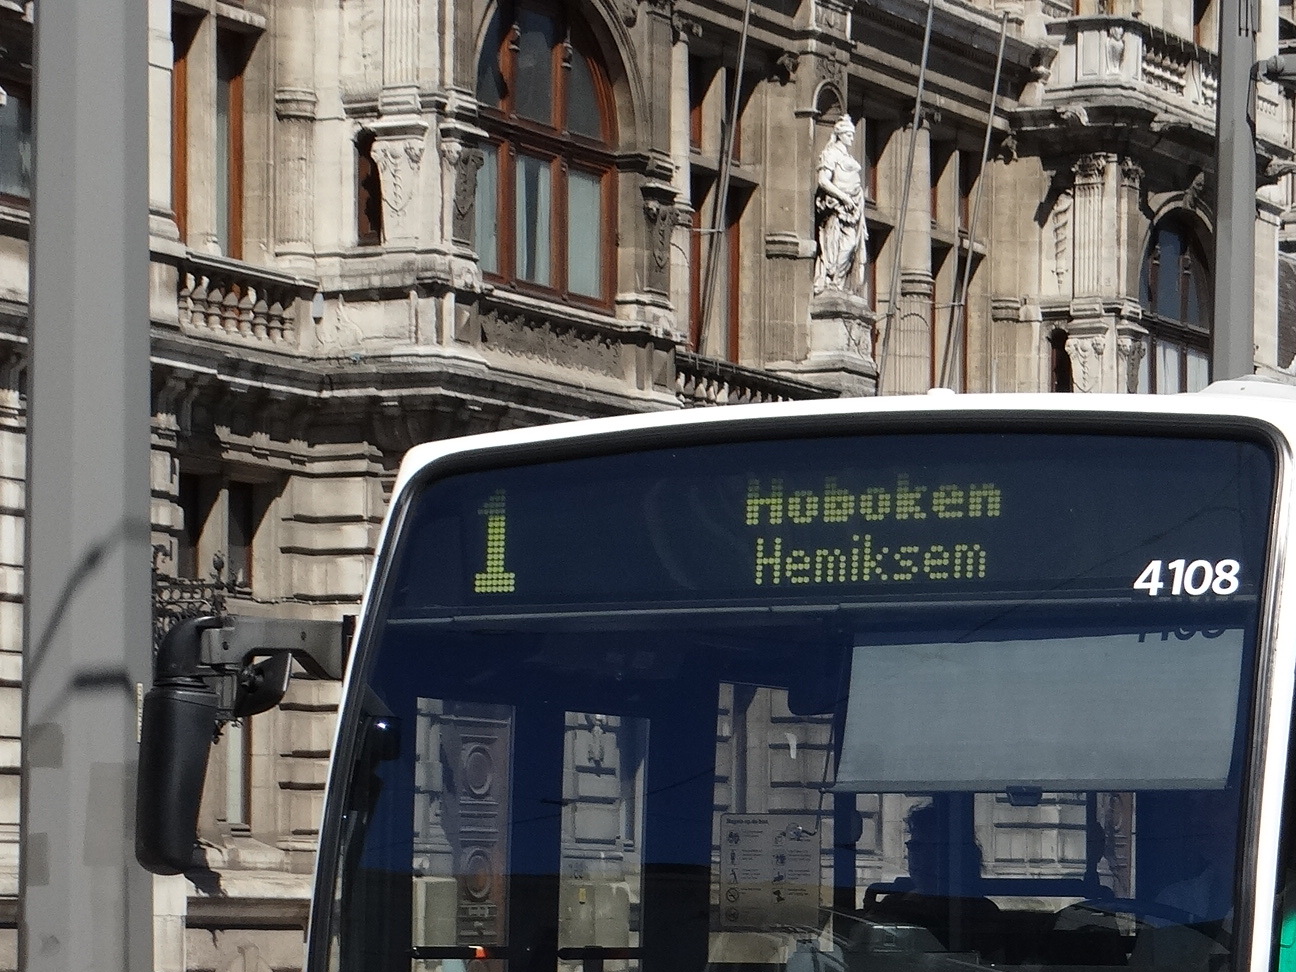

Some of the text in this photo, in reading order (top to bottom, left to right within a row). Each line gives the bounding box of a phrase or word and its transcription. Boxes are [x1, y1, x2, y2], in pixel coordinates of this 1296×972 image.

[746, 473, 1001, 525] Hoboken
[474, 488, 516, 593] 1
[755, 533, 987, 585] Hemiksem
[1132, 558, 1241, 597] 4108
